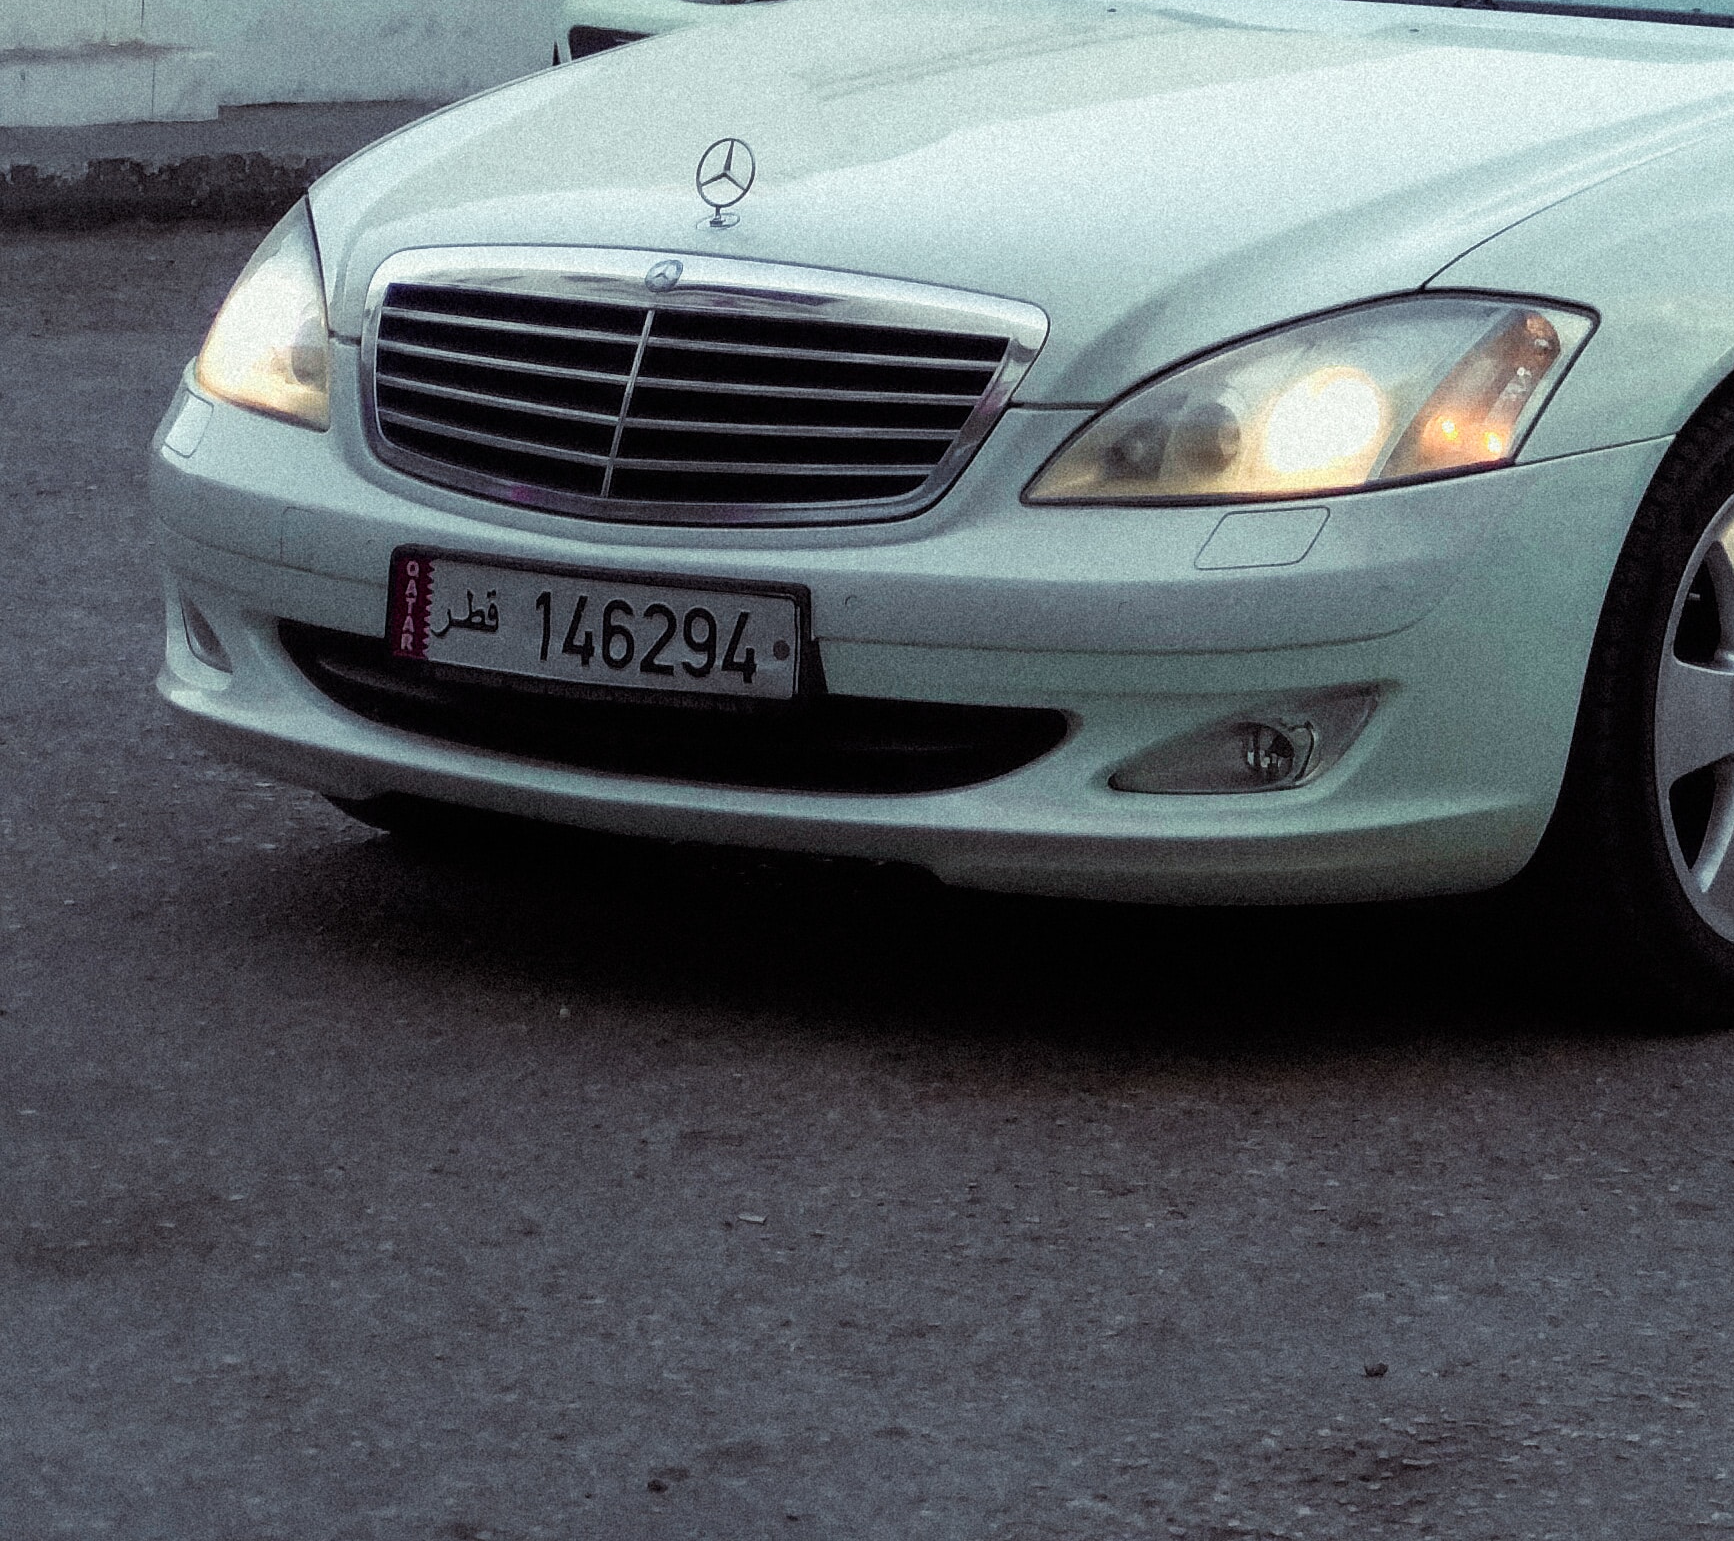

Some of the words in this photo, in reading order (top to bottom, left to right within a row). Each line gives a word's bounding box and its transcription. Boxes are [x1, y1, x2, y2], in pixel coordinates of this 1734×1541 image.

[401, 560, 420, 652] QATAR
[430, 588, 499, 638] قطر
[535, 590, 757, 684] 146294
